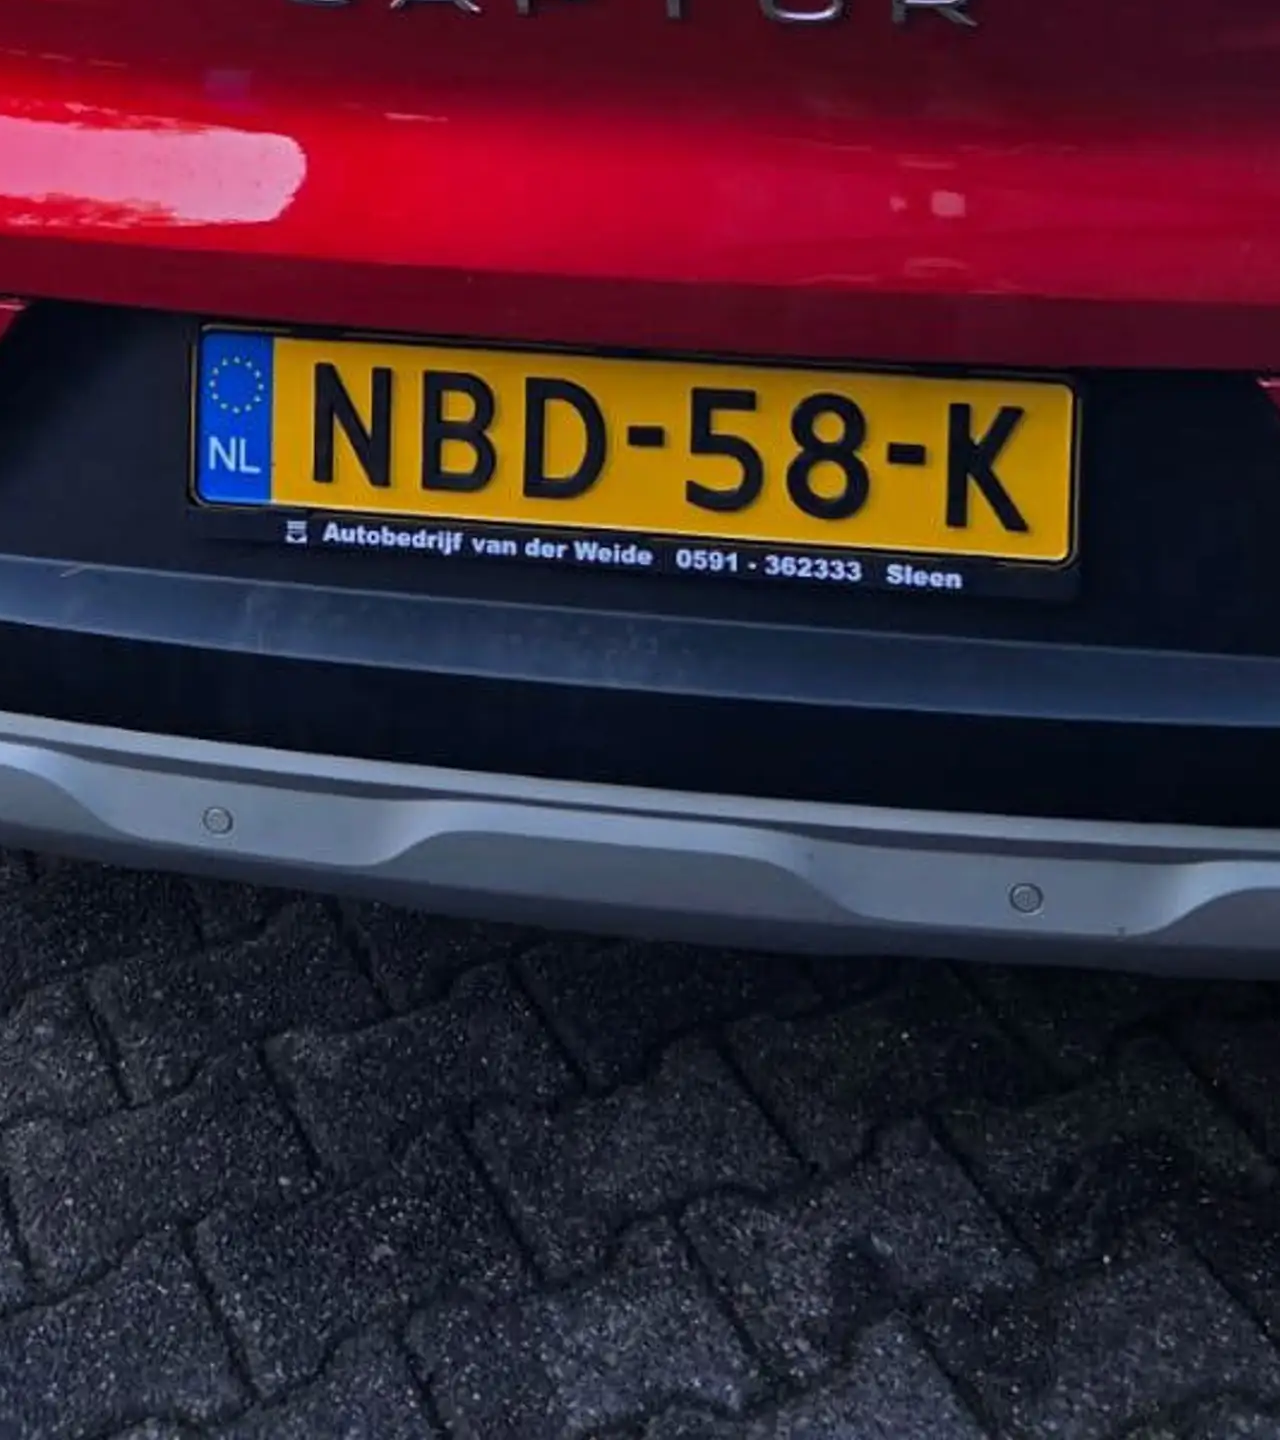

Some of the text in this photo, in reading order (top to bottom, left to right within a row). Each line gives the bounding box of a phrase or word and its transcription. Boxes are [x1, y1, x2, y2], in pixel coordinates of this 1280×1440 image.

[208, 436, 261, 474] NL
[310, 361, 1032, 536] NBD-58-K
[322, 522, 464, 557] Autobedrijf
[471, 536, 517, 557] van
[524, 536, 568, 560] der
[573, 539, 654, 567] Weide
[675, 547, 739, 573] 0591
[765, 554, 863, 583] 362333
[885, 562, 963, 590] Sleen
